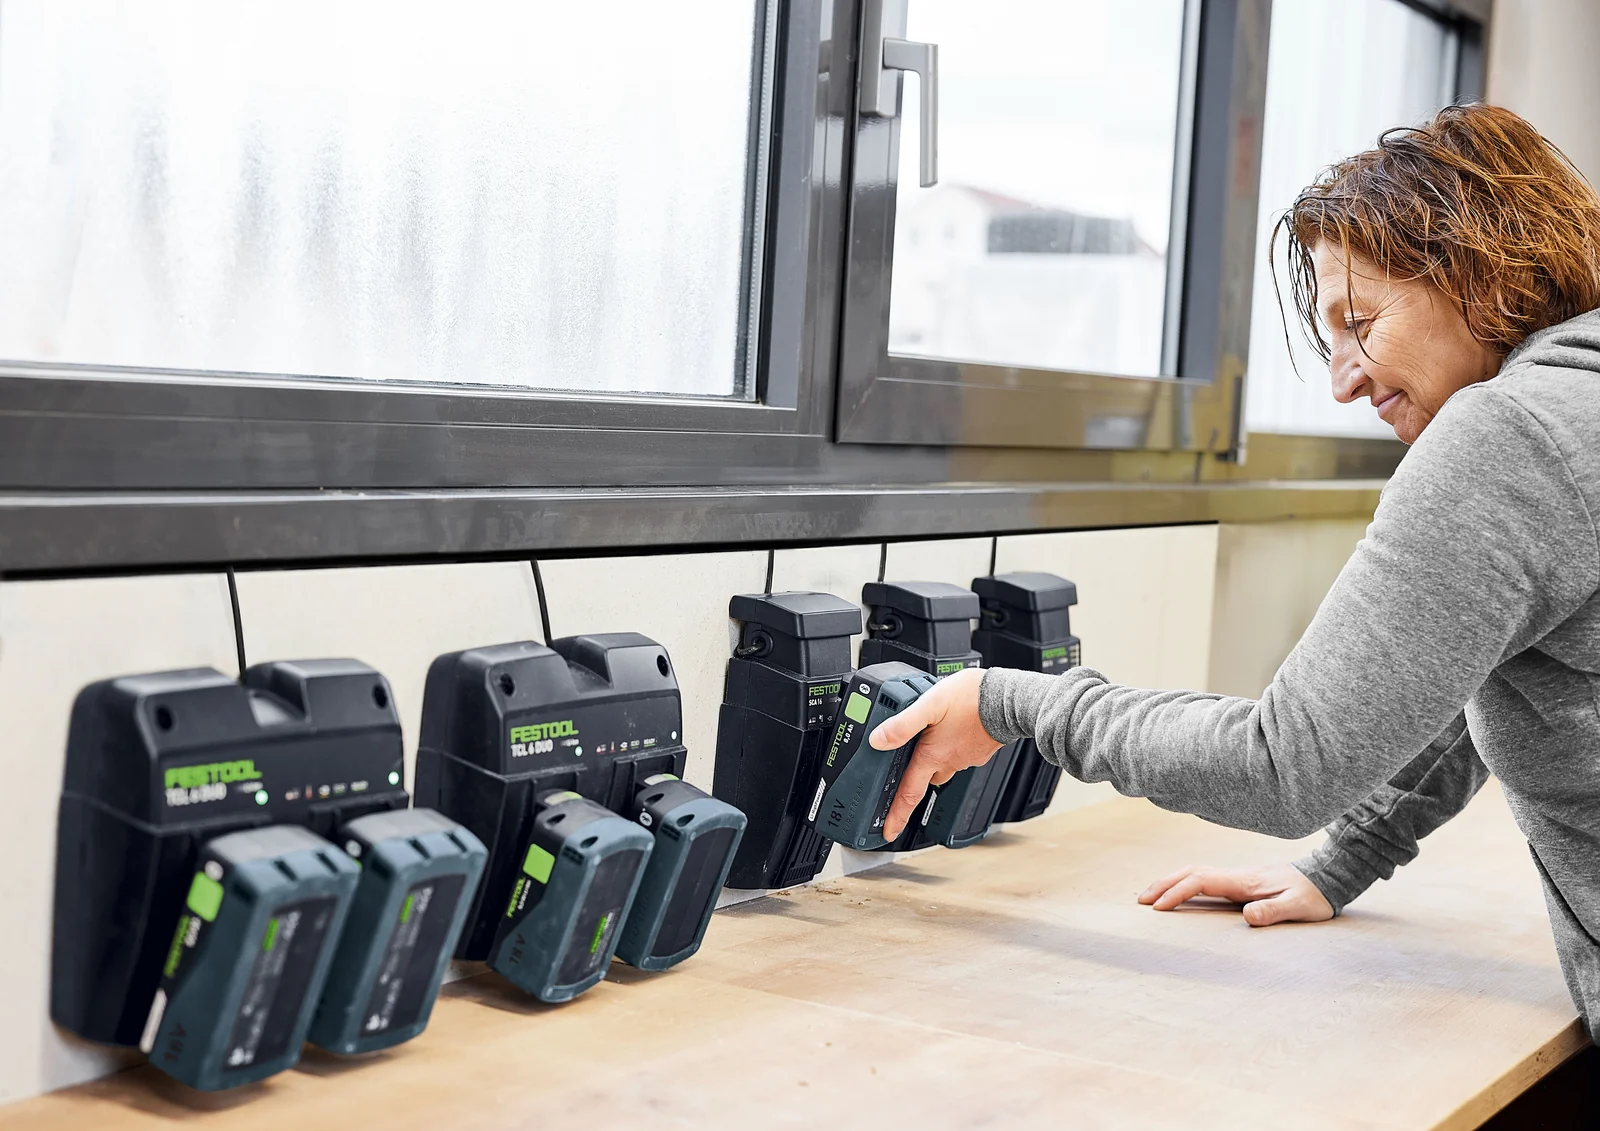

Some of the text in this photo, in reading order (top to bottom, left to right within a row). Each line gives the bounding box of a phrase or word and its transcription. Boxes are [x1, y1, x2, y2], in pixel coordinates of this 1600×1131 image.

[808, 698, 818, 706] SCA
[510, 720, 579, 744] FESTOOL
[510, 743, 529, 758] TCL
[534, 738, 554, 754] DUO
[826, 721, 848, 767] FESTOOL
